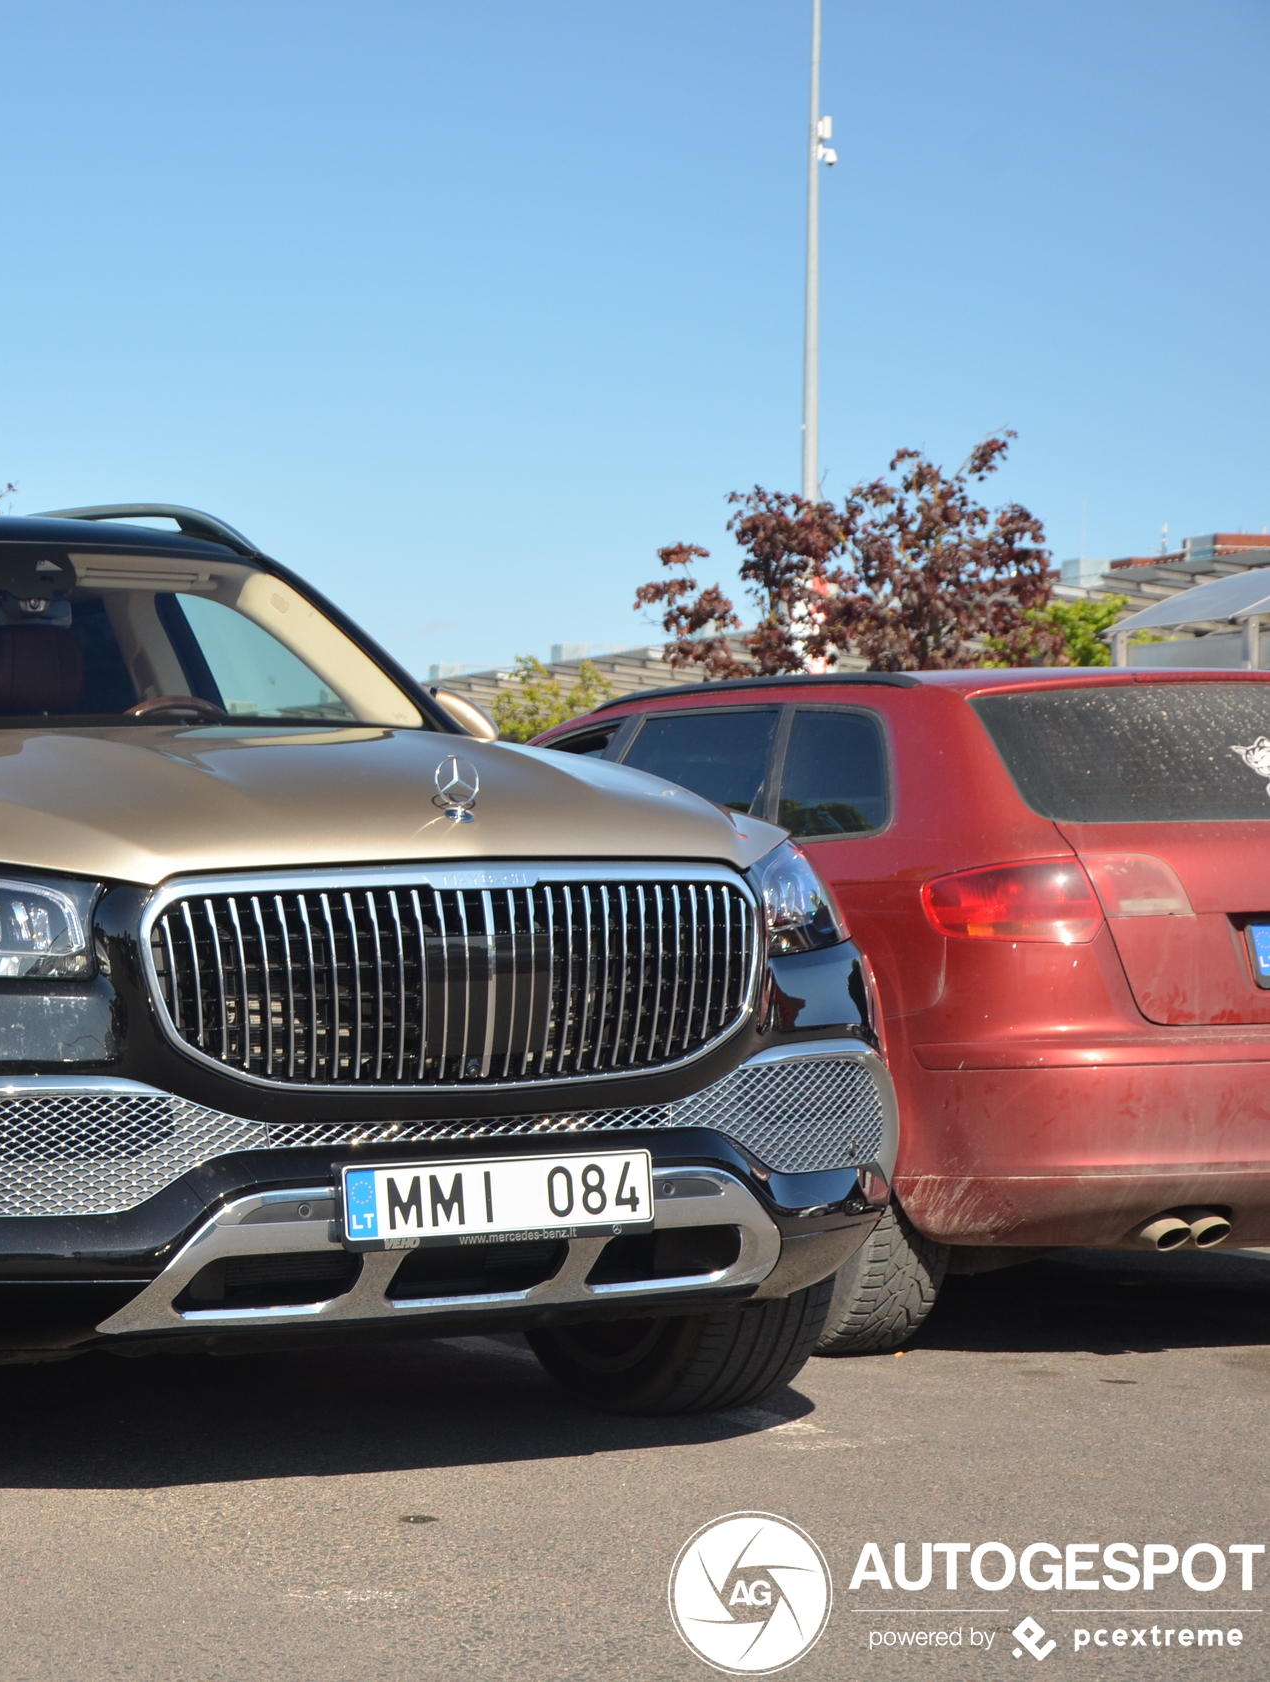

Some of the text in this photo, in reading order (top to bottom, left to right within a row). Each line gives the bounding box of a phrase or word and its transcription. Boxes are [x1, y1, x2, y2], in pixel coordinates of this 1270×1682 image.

[442, 873, 528, 887] MAYBACH
[386, 1161, 640, 1230] MMI 084
[352, 1212, 375, 1230] LT
[384, 1237, 420, 1250] VEHO
[459, 1226, 577, 1245] www.mercedes-benz.lt
